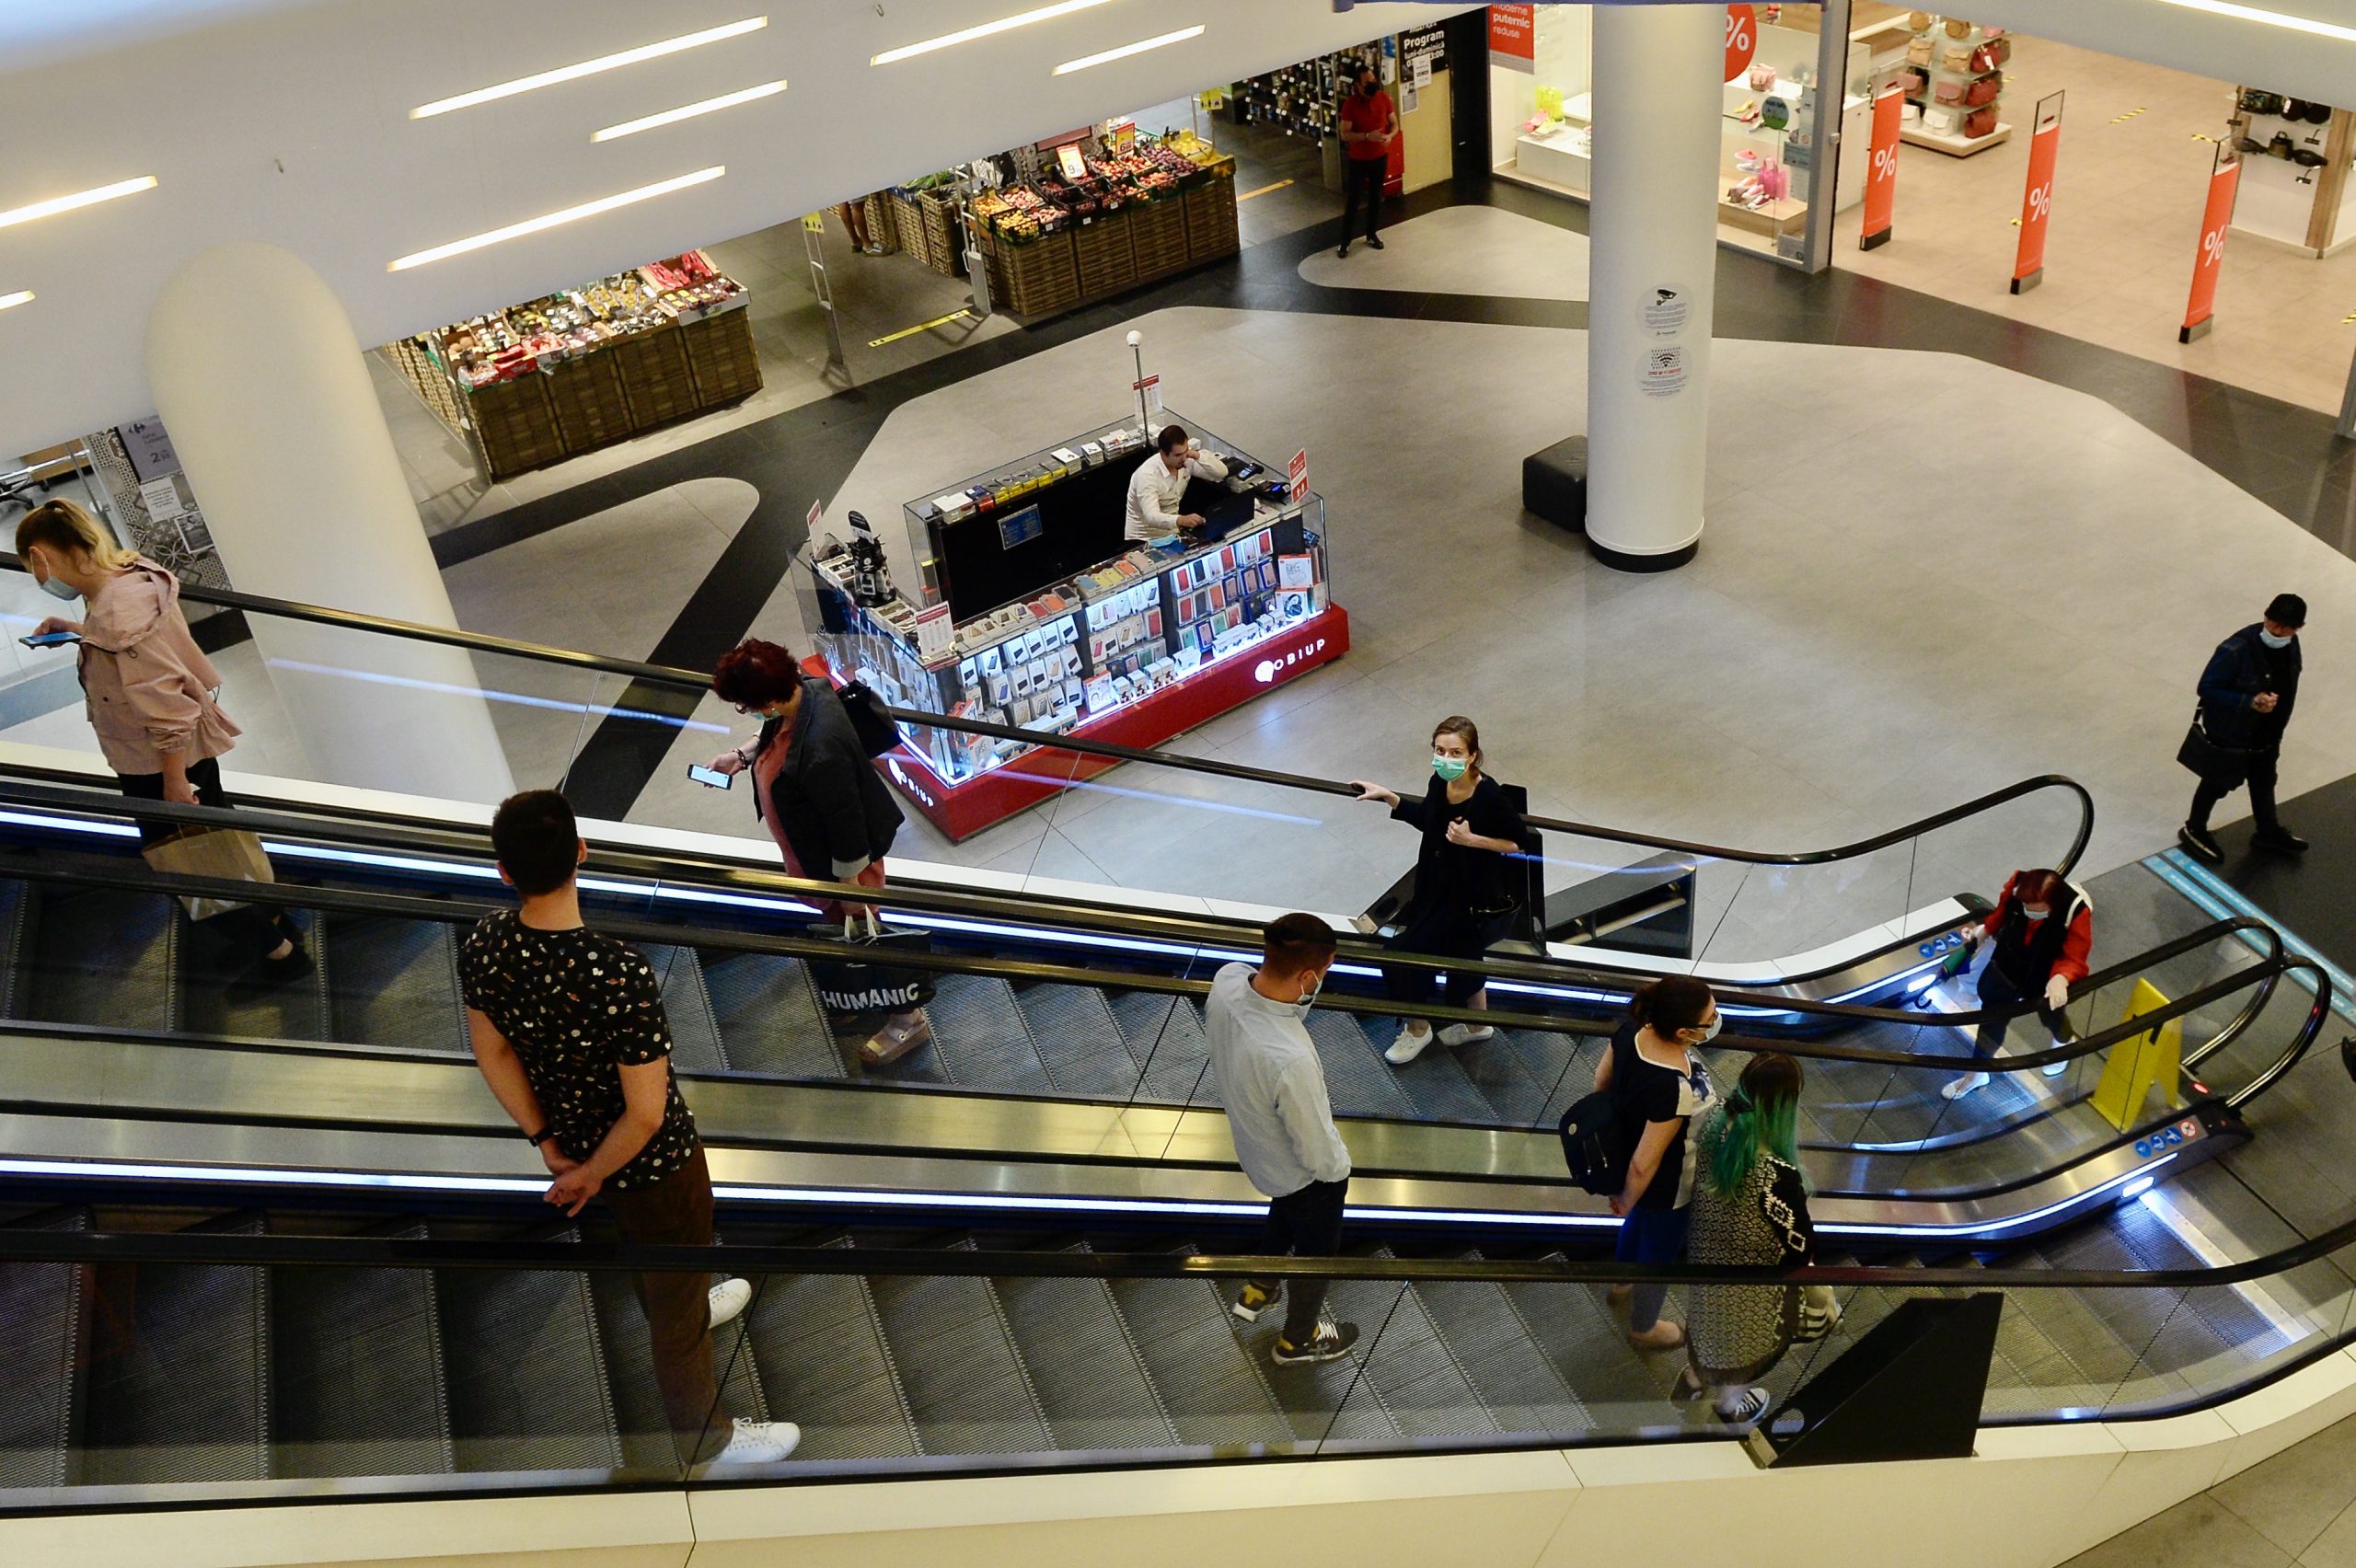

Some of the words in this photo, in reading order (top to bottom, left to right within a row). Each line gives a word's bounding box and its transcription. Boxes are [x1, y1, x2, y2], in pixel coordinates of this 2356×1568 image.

[1493, 13, 1530, 29] puternic
[1493, 26, 1520, 39] reduse
[1403, 30, 1445, 50] Program
[1875, 144, 1896, 182] %
[2029, 181, 2050, 222] %
[2204, 224, 2225, 268] %
[821, 982, 919, 1010] HUMANIC
